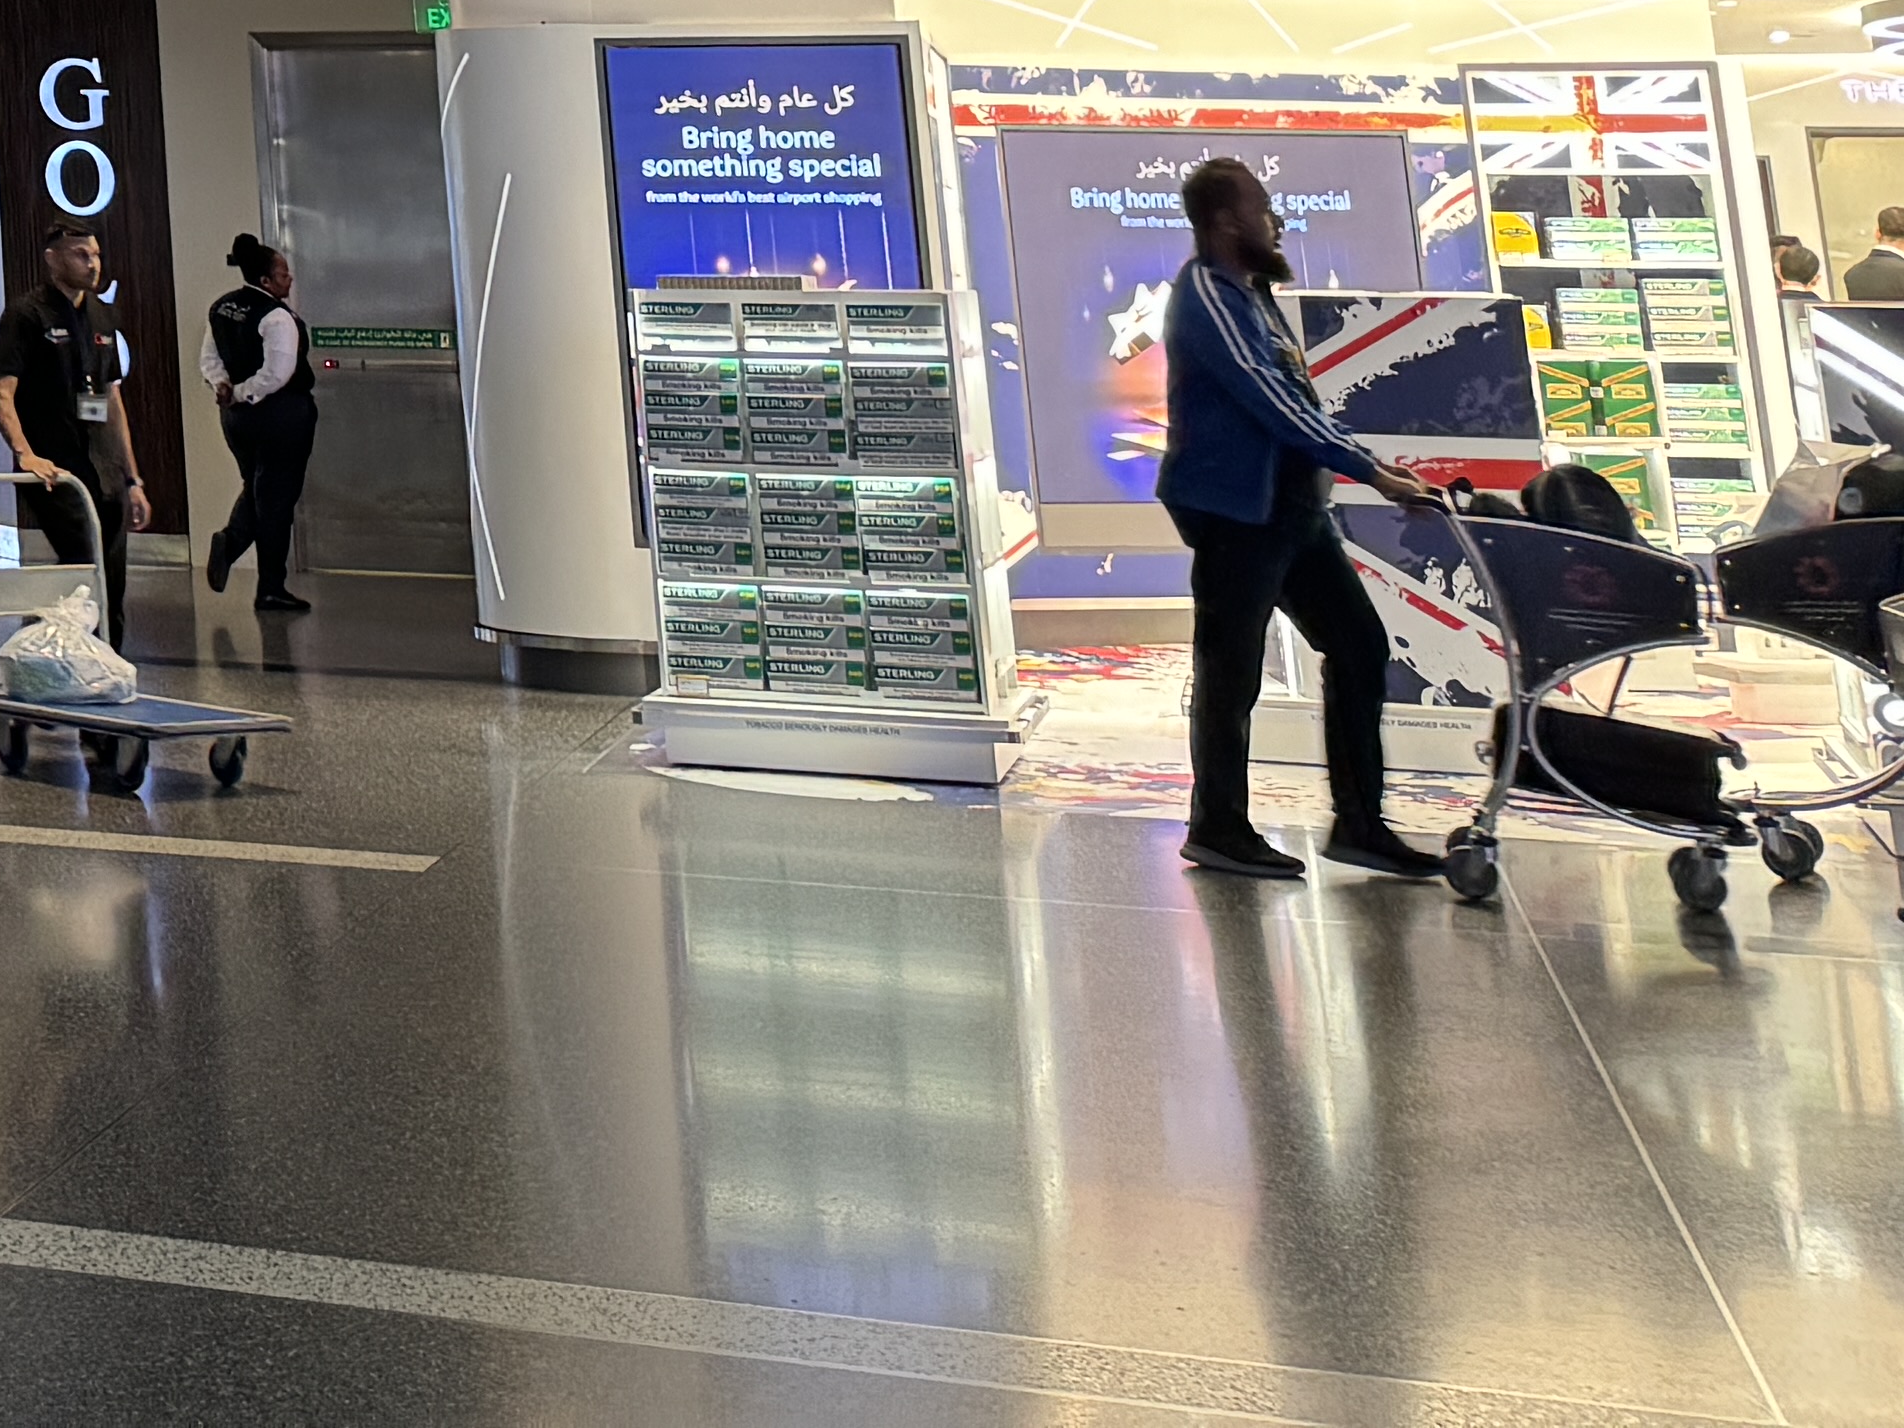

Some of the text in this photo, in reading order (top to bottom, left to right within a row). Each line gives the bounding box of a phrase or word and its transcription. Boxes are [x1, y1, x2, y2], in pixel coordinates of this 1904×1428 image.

[654, 78, 855, 117] كل عام وأنتم بخير
[681, 125, 836, 155] Bring home
[641, 152, 882, 184] something special
[1136, 156, 1176, 178] بخير
[645, 190, 677, 204] from
[678, 191, 700, 204] the
[747, 191, 776, 204] best
[777, 191, 822, 206] airport
[823, 191, 883, 207] shopping
[1070, 186, 1352, 215] Bring home special
[640, 304, 694, 315] STERLING
[848, 306, 904, 318] STERLING
[911, 326, 928, 335] kills
[645, 362, 700, 372] STERLING
[747, 364, 803, 375] STERLING
[852, 366, 908, 378] STERLING
[704, 382, 722, 391] kills
[808, 384, 825, 393] kills
[915, 387, 932, 396] kills
[646, 395, 702, 406] STERLING
[749, 397, 805, 409] STERLING
[706, 416, 723, 424] kills
[810, 418, 828, 427] kills
[649, 429, 704, 441] STERLING
[752, 431, 808, 444] STERLING
[709, 449, 726, 459] kills
[814, 453, 832, 463] kills
[654, 475, 709, 486] STERLING
[760, 478, 815, 491] STERLING
[858, 481, 914, 492] STERLING
[821, 500, 838, 510] kills
[919, 501, 936, 511] kills
[658, 506, 708, 519] STERLING
[763, 513, 818, 526] STERLING
[860, 515, 917, 528] STERLING
[823, 534, 842, 544] kills
[923, 536, 941, 546] kills
[659, 543, 716, 556] STERLING
[765, 548, 822, 561] STERLING
[868, 551, 925, 564] STERLING
[827, 569, 845, 580] kills
[931, 572, 950, 582] kills
[663, 587, 719, 600] STERLING
[764, 590, 822, 604] STERLING
[869, 596, 927, 609] STERLING
[826, 613, 845, 624] kills
[932, 618, 951, 628] kills
[666, 621, 721, 634] STERLING
[767, 626, 825, 640] STERLING
[874, 631, 931, 645] STERLING
[829, 648, 848, 658] kills
[669, 656, 724, 670] STERLING
[769, 662, 825, 675] STERLING
[877, 668, 934, 681] STERLING
